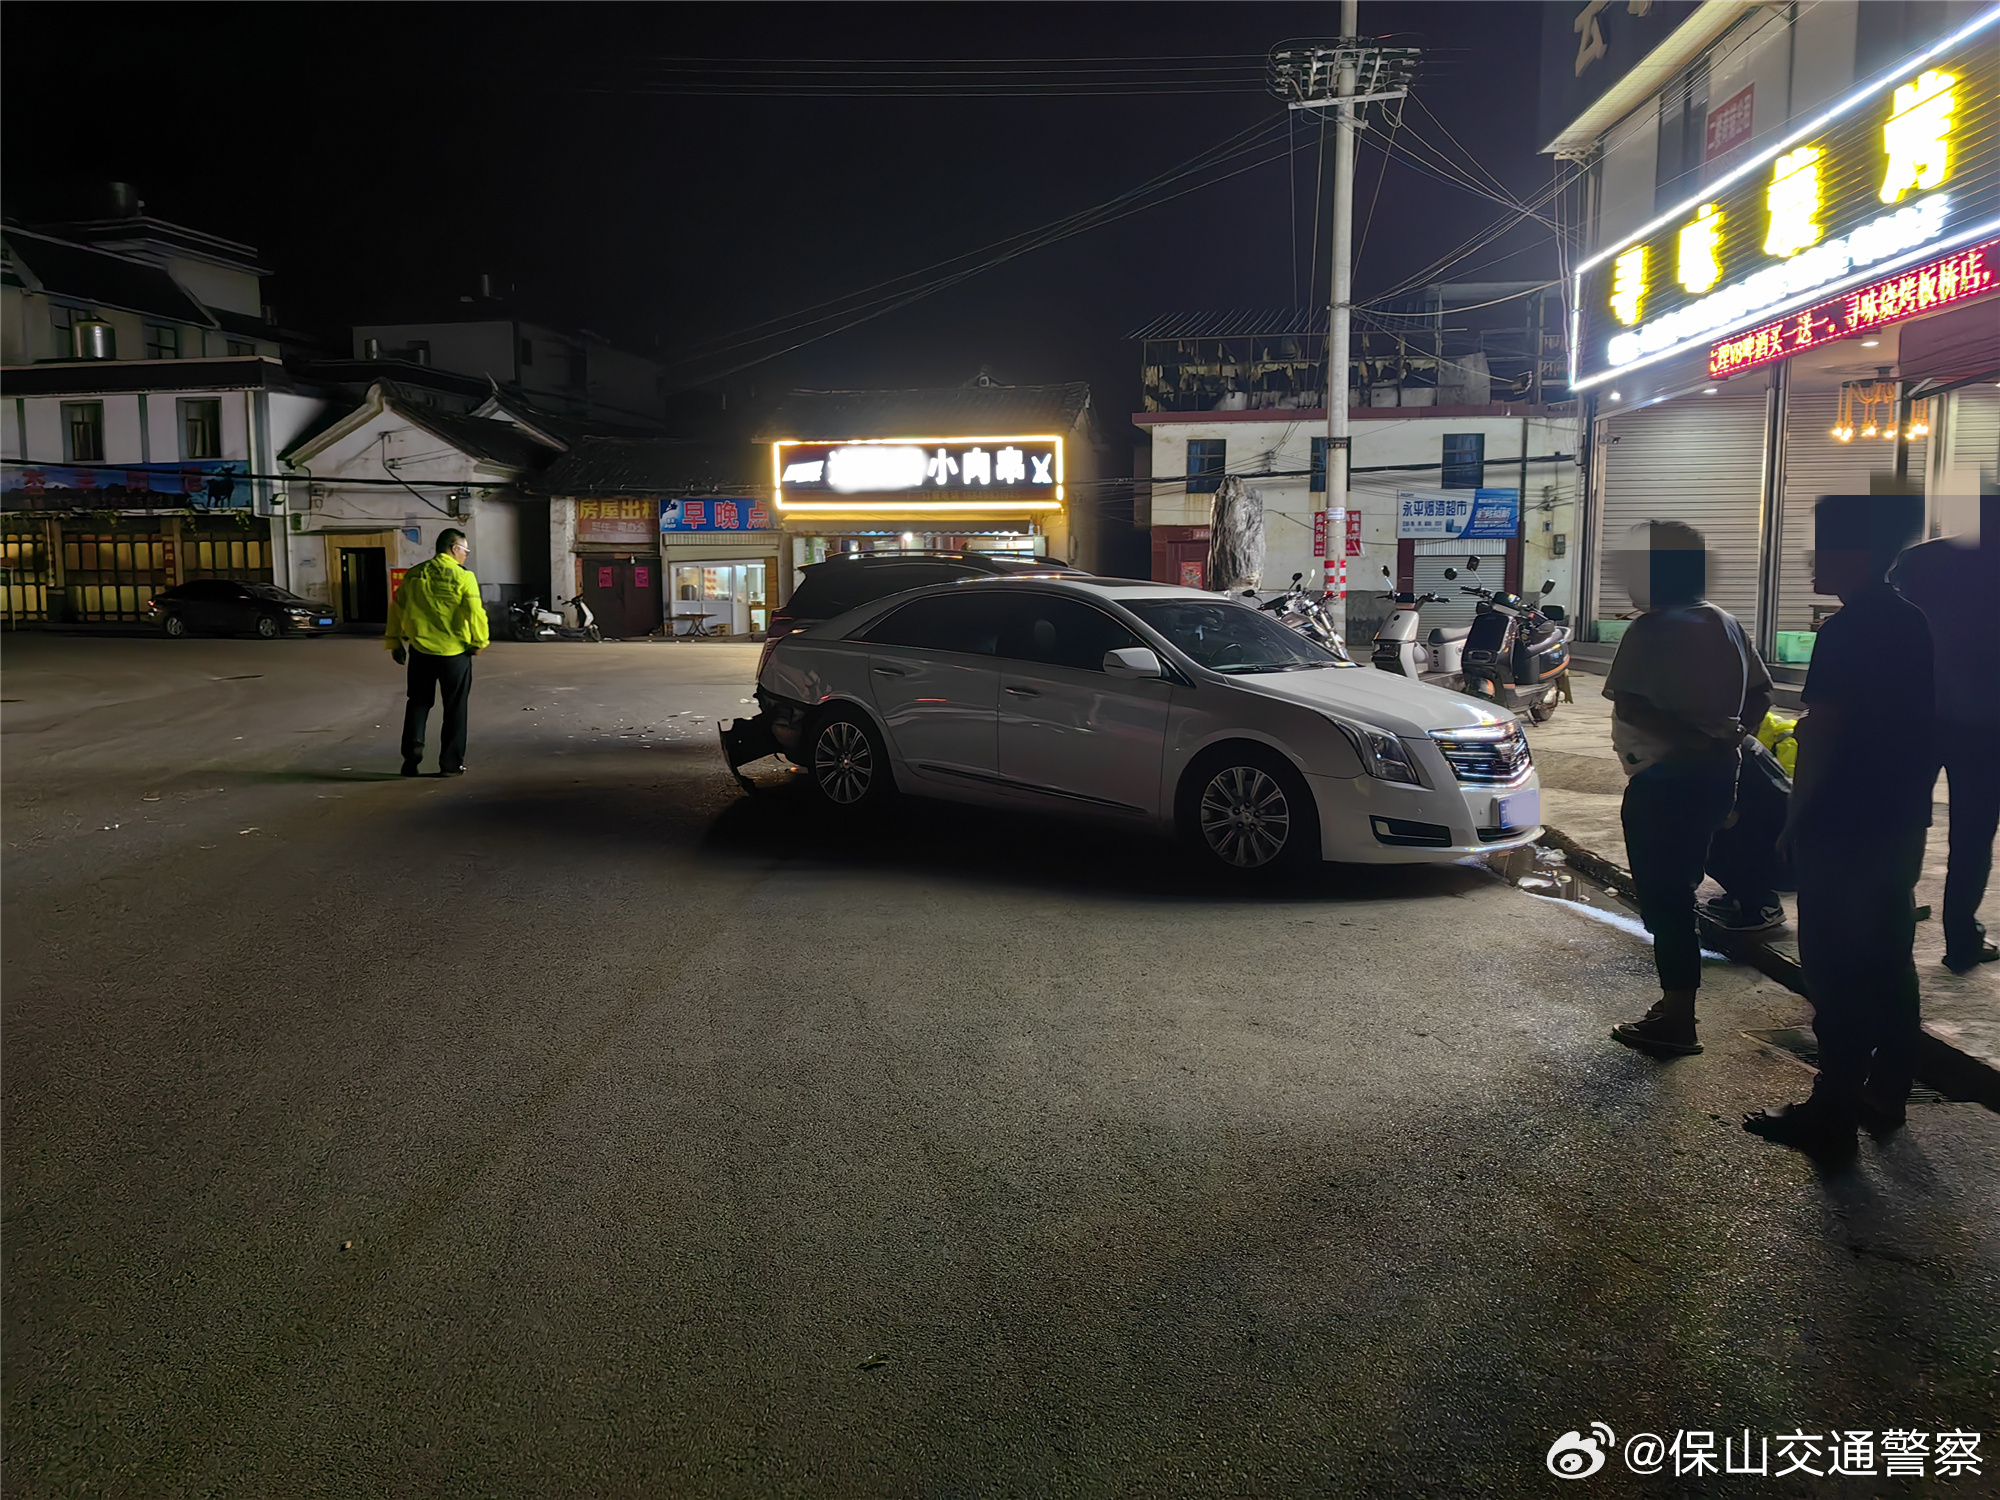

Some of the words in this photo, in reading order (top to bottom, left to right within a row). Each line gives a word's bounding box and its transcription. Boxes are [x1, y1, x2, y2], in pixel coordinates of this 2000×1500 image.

[682, 499, 770, 529] 早晚点
[1402, 500, 1468, 517] 永平烟酒超市
